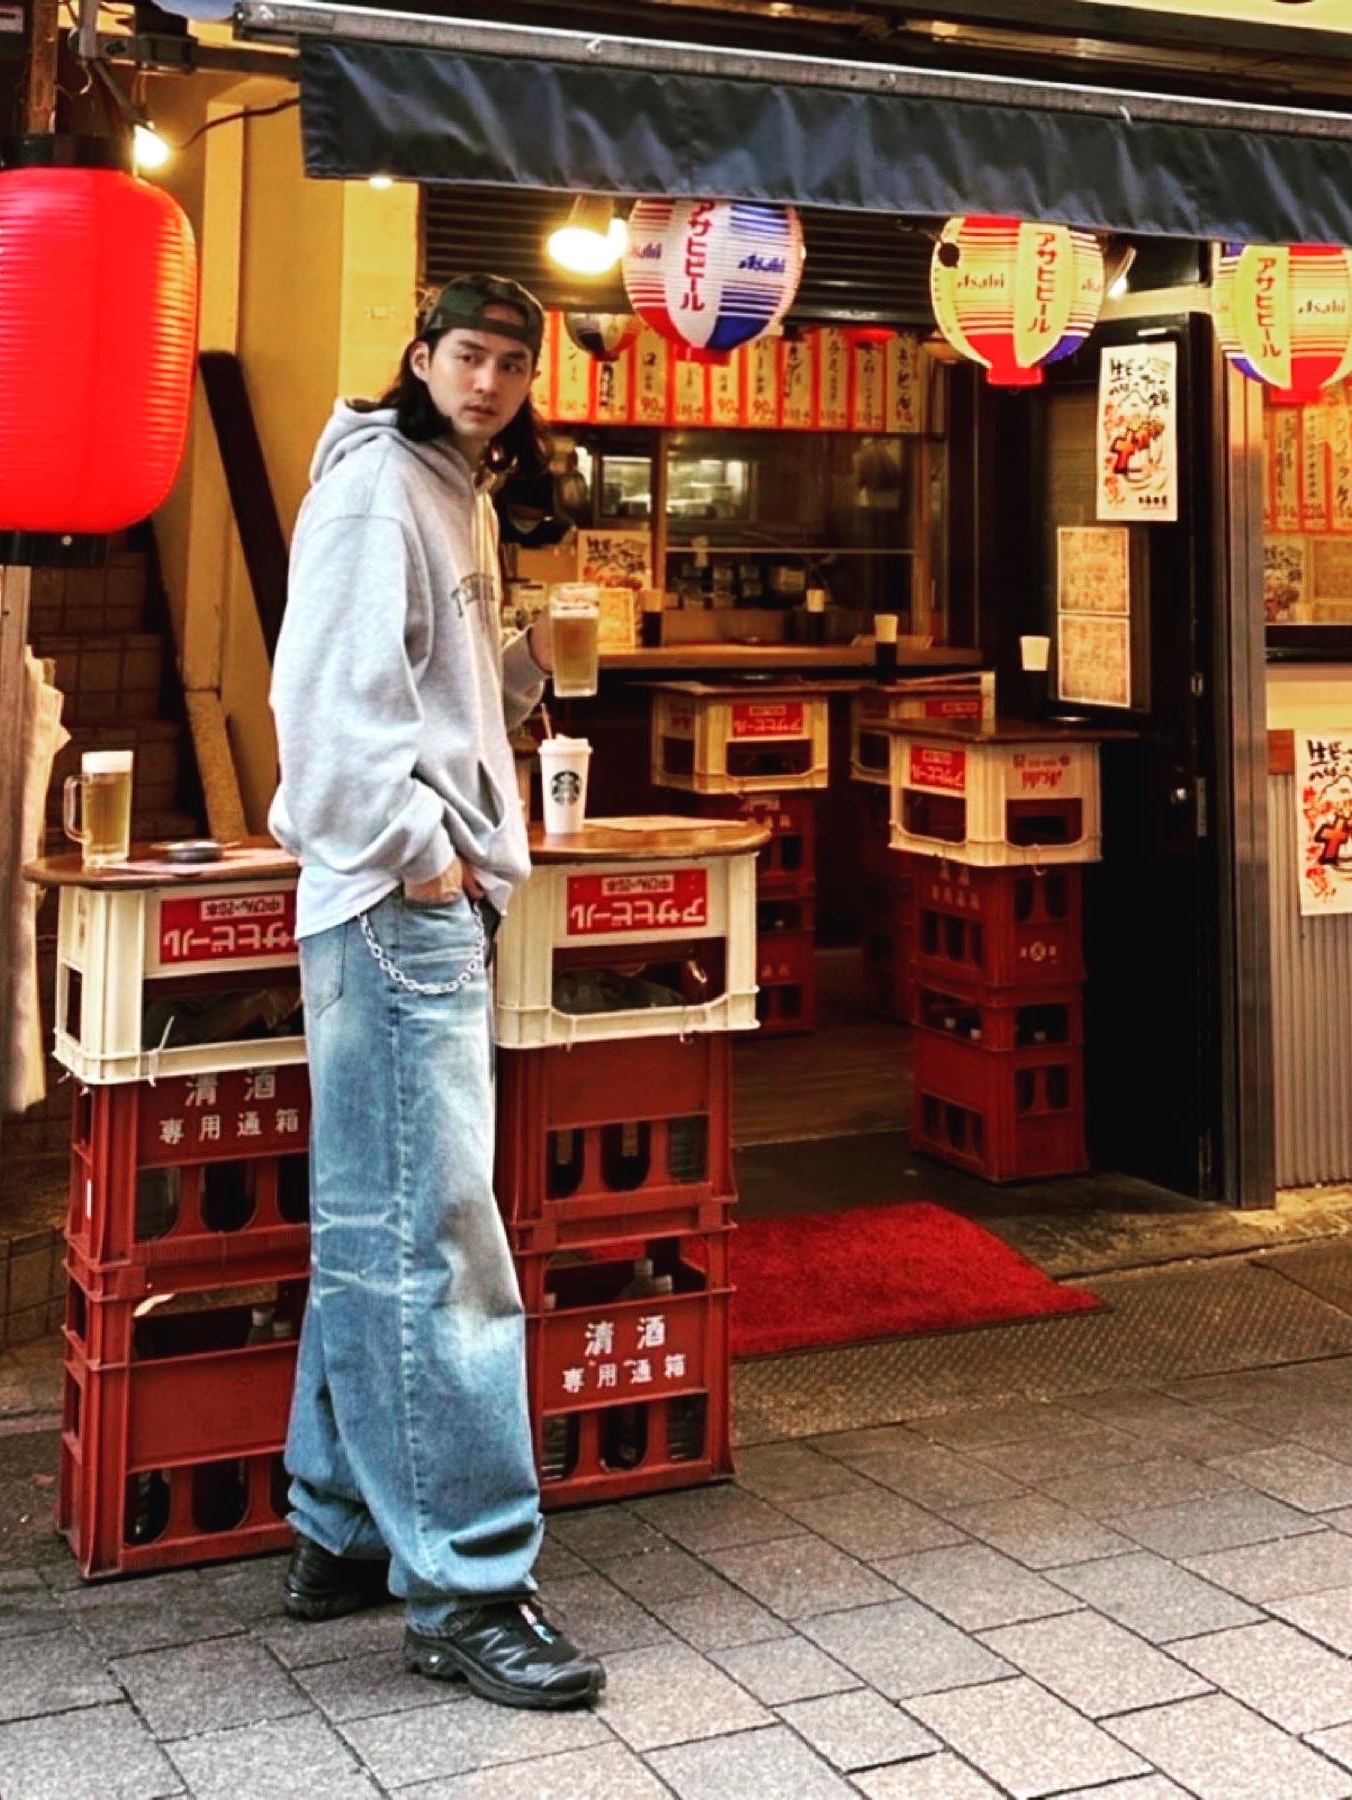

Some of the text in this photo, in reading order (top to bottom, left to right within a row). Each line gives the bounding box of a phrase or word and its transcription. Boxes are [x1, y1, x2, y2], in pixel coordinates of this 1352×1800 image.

[680, 199, 715, 312] アサヒビール
[738, 253, 786, 273] Asahi
[958, 273, 1004, 289] Asahi
[1028, 232, 1057, 334] アサヒビール
[1256, 257, 1281, 357] アサヒビール
[1298, 300, 1345, 314] Asahi
[571, 898, 704, 929] アサヒビール
[163, 921, 297, 956] サヒビール
[185, 1067, 277, 1106] 清酒
[585, 1314, 665, 1353] 清酒
